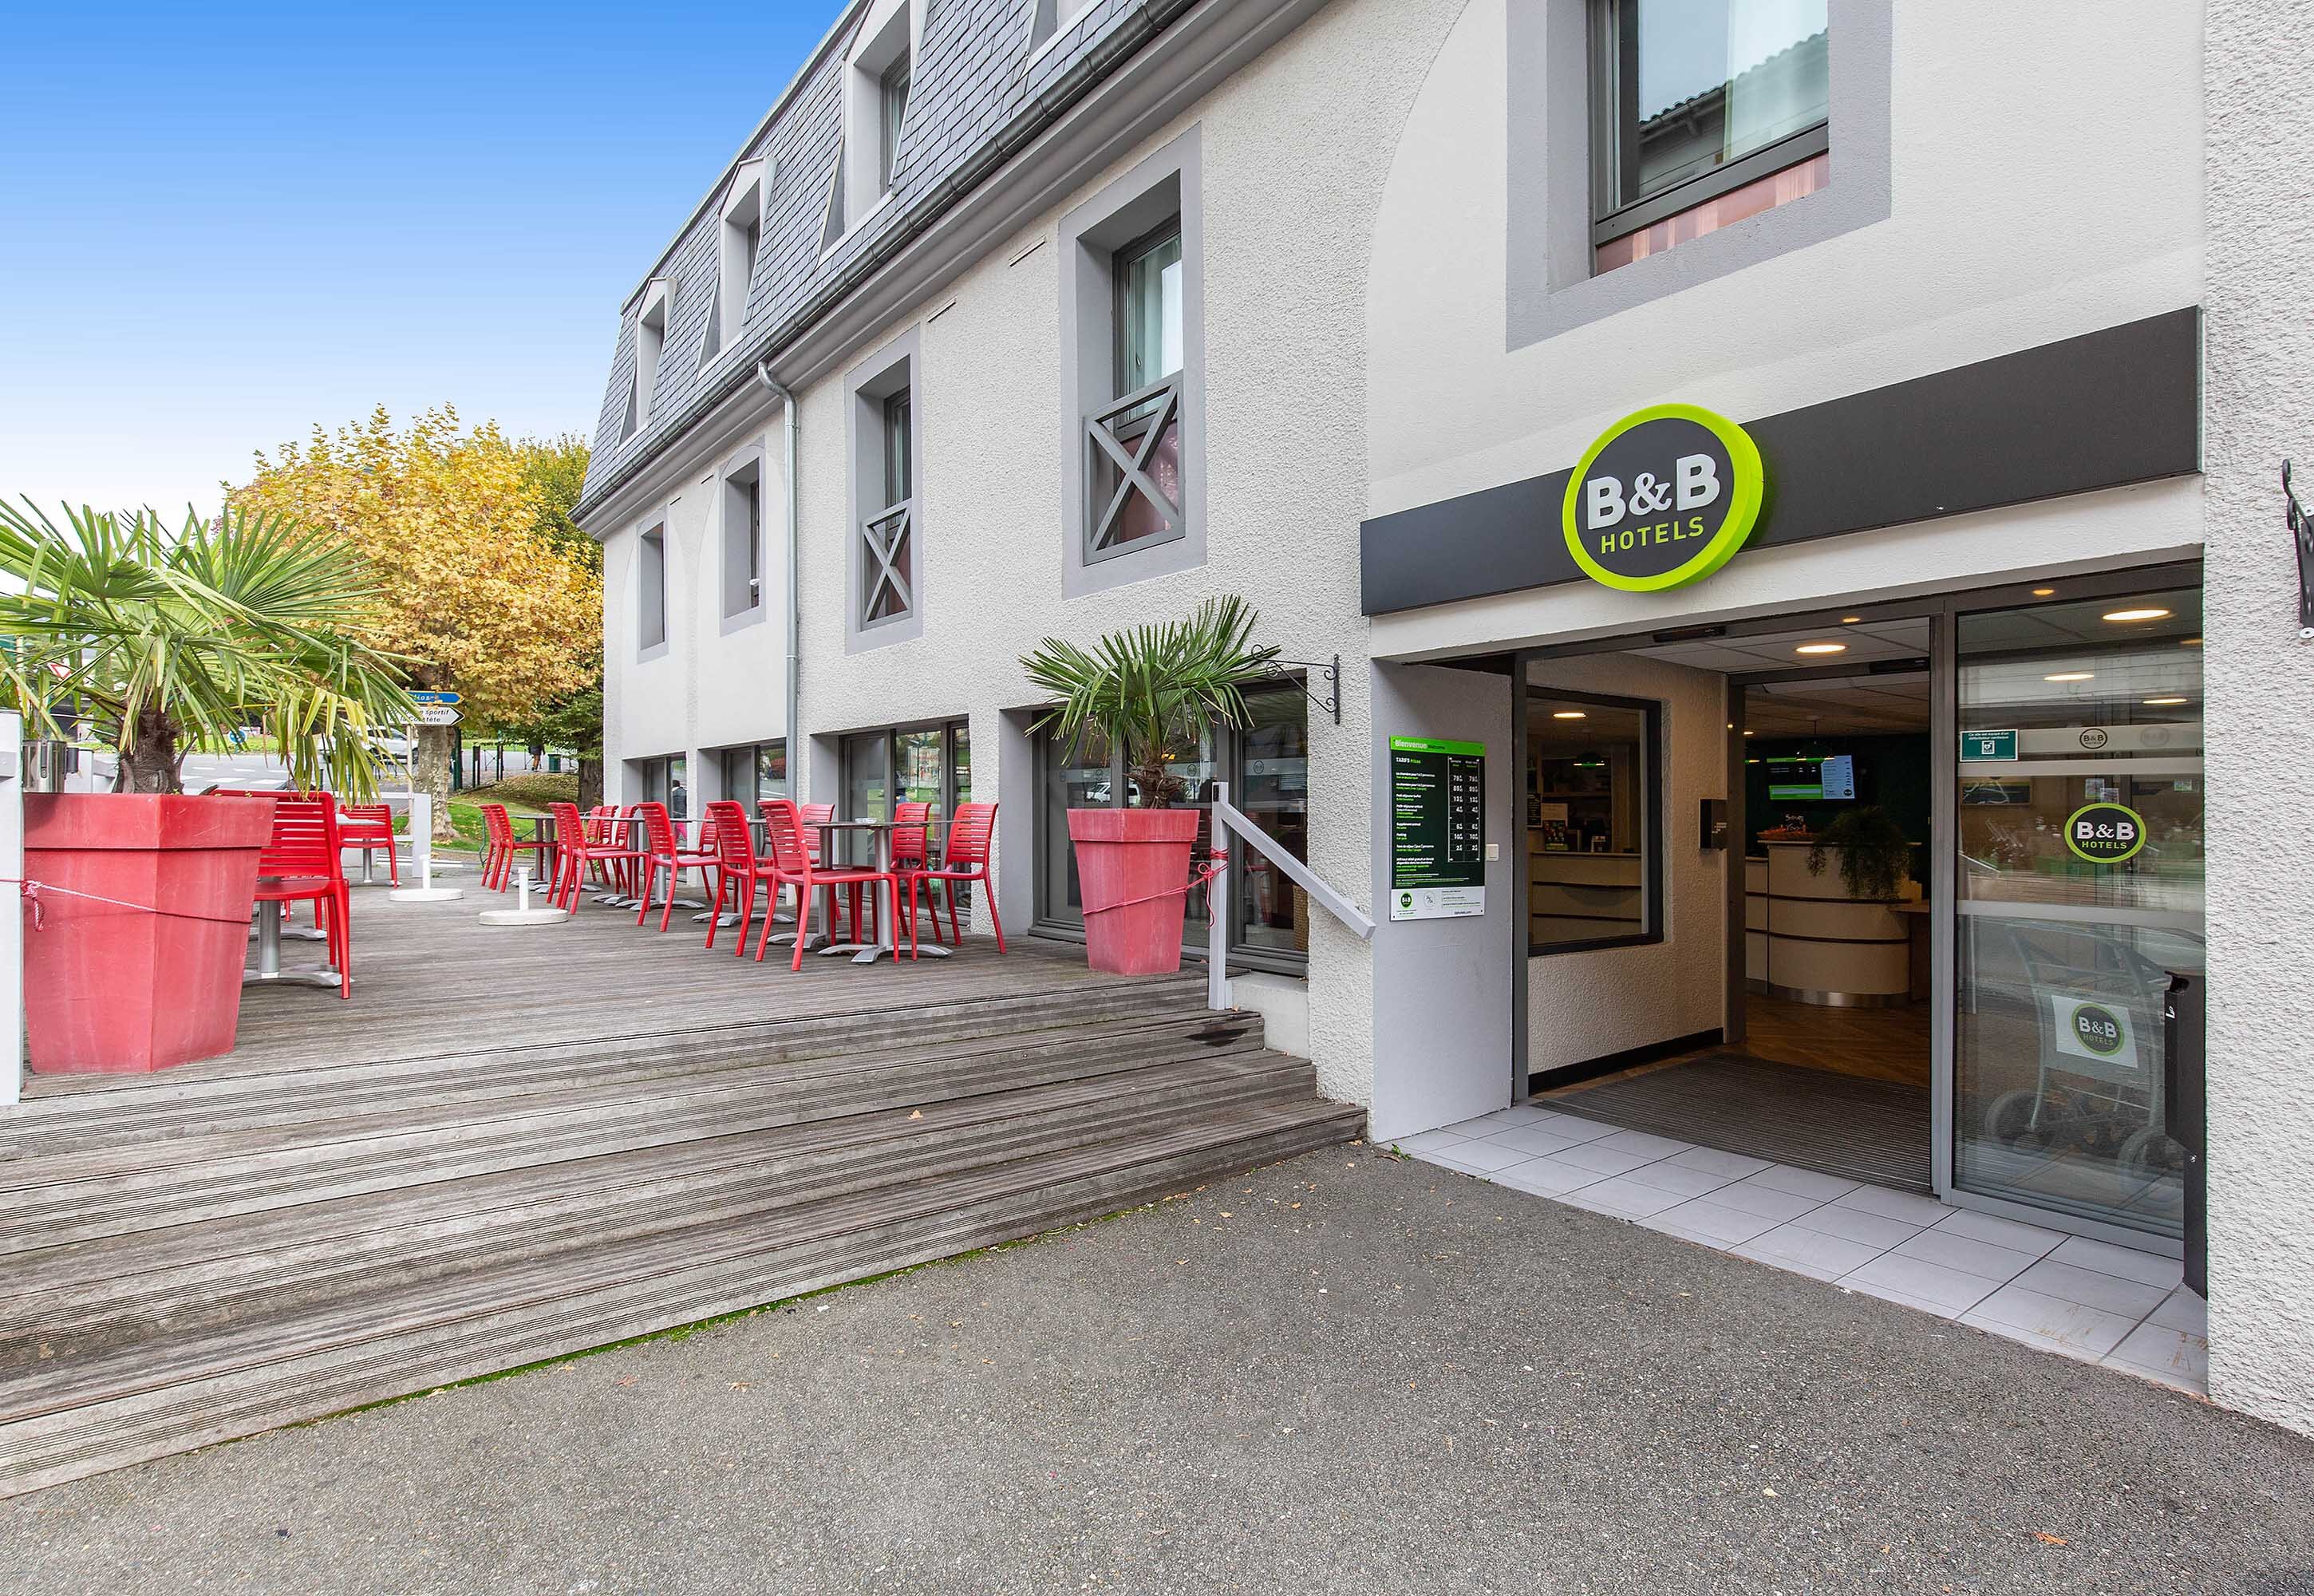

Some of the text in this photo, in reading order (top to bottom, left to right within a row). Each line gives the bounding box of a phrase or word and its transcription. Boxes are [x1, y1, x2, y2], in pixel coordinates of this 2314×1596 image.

[1586, 452, 1721, 530] B&B
[1600, 516, 1705, 555] HOTELS
[2077, 821, 2134, 840] B&B
[2079, 1016, 2117, 1038] B&B
[2083, 1033, 2114, 1045] HOTELS
